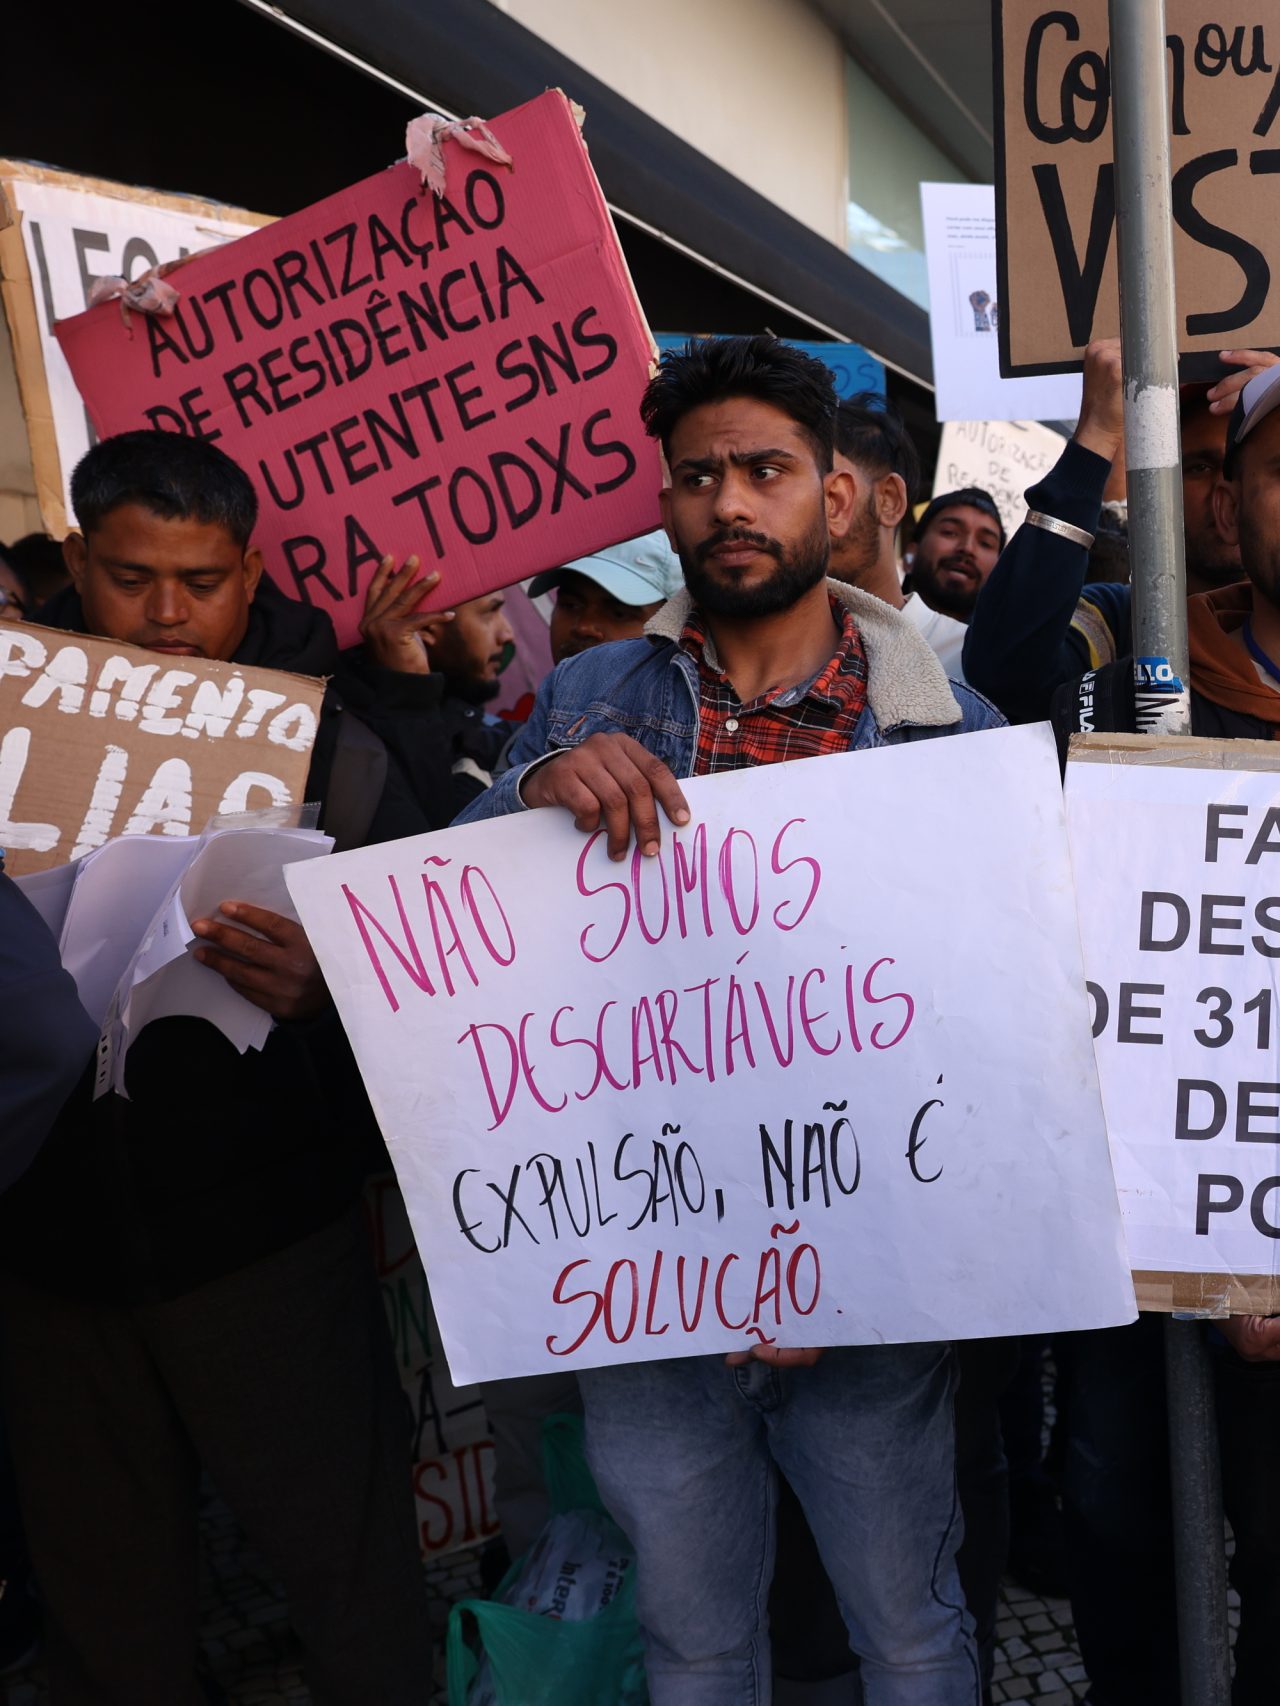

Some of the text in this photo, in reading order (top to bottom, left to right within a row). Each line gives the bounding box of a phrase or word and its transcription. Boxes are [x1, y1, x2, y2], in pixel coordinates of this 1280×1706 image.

[1024, 11, 1190, 143] Co
[1195, 23, 1272, 76] ou
[222, 245, 545, 428] RESIDÊNCIA
[259, 306, 617, 510] UTENTE SNS
[392, 408, 637, 559] TODXS
[341, 818, 822, 1012] NÃO SOMOS
